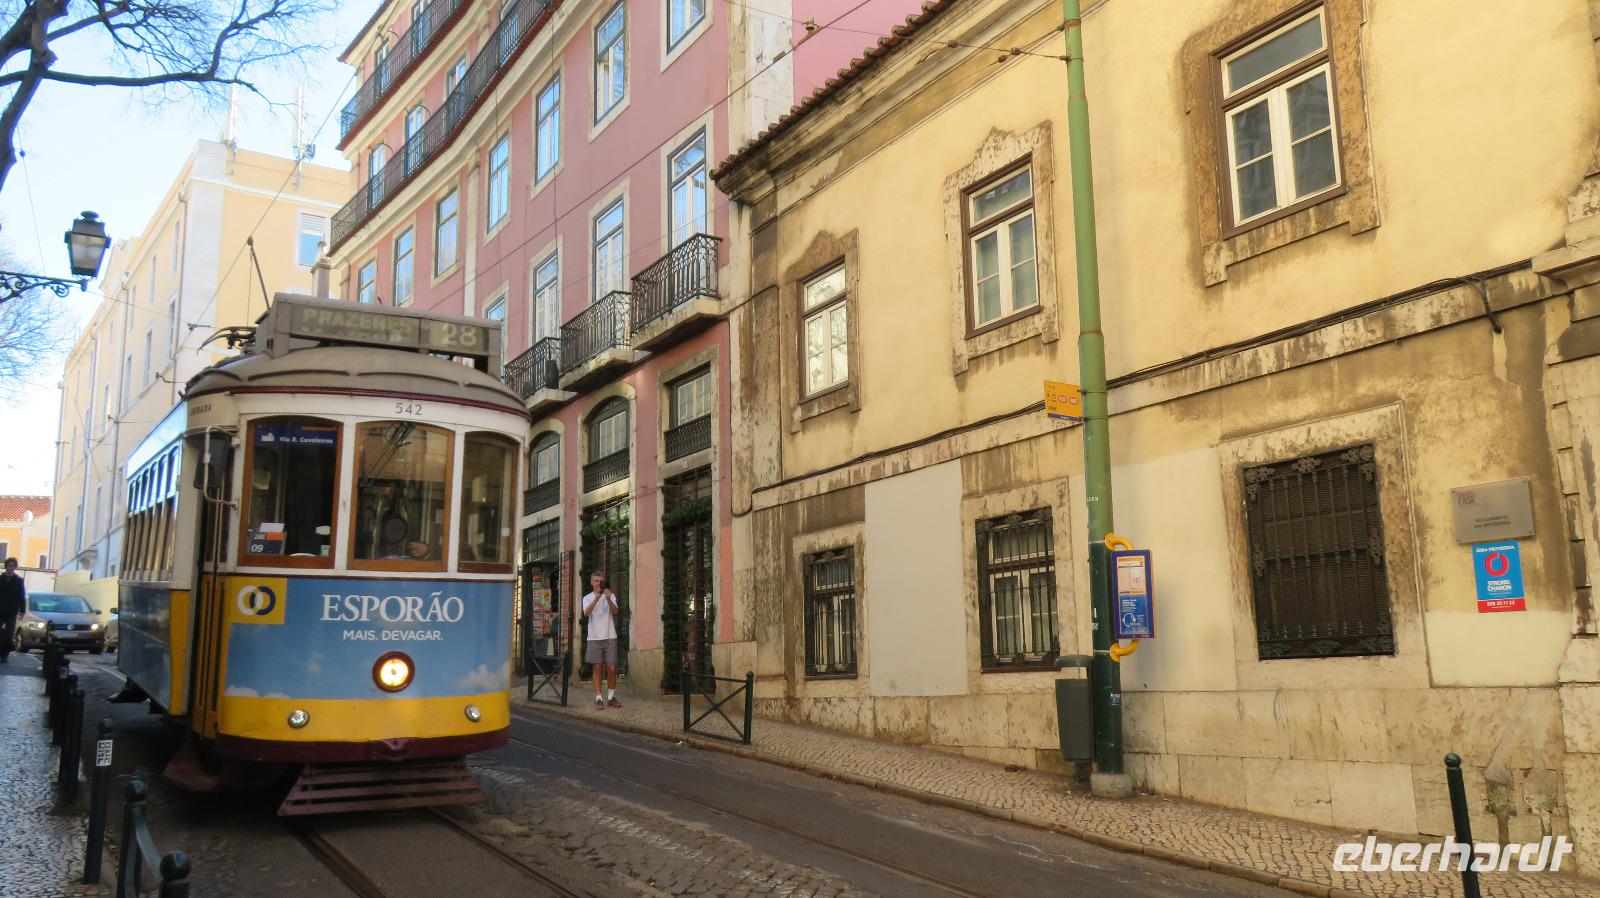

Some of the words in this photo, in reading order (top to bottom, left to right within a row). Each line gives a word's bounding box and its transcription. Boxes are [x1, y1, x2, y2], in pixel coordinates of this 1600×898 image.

[440, 323, 477, 346] 28
[395, 402, 423, 416] 542
[251, 544, 264, 553] 09
[320, 591, 464, 623] ESPORÃO
[343, 629, 378, 641] MAIS.
[382, 629, 443, 641] DEVAGAR.
